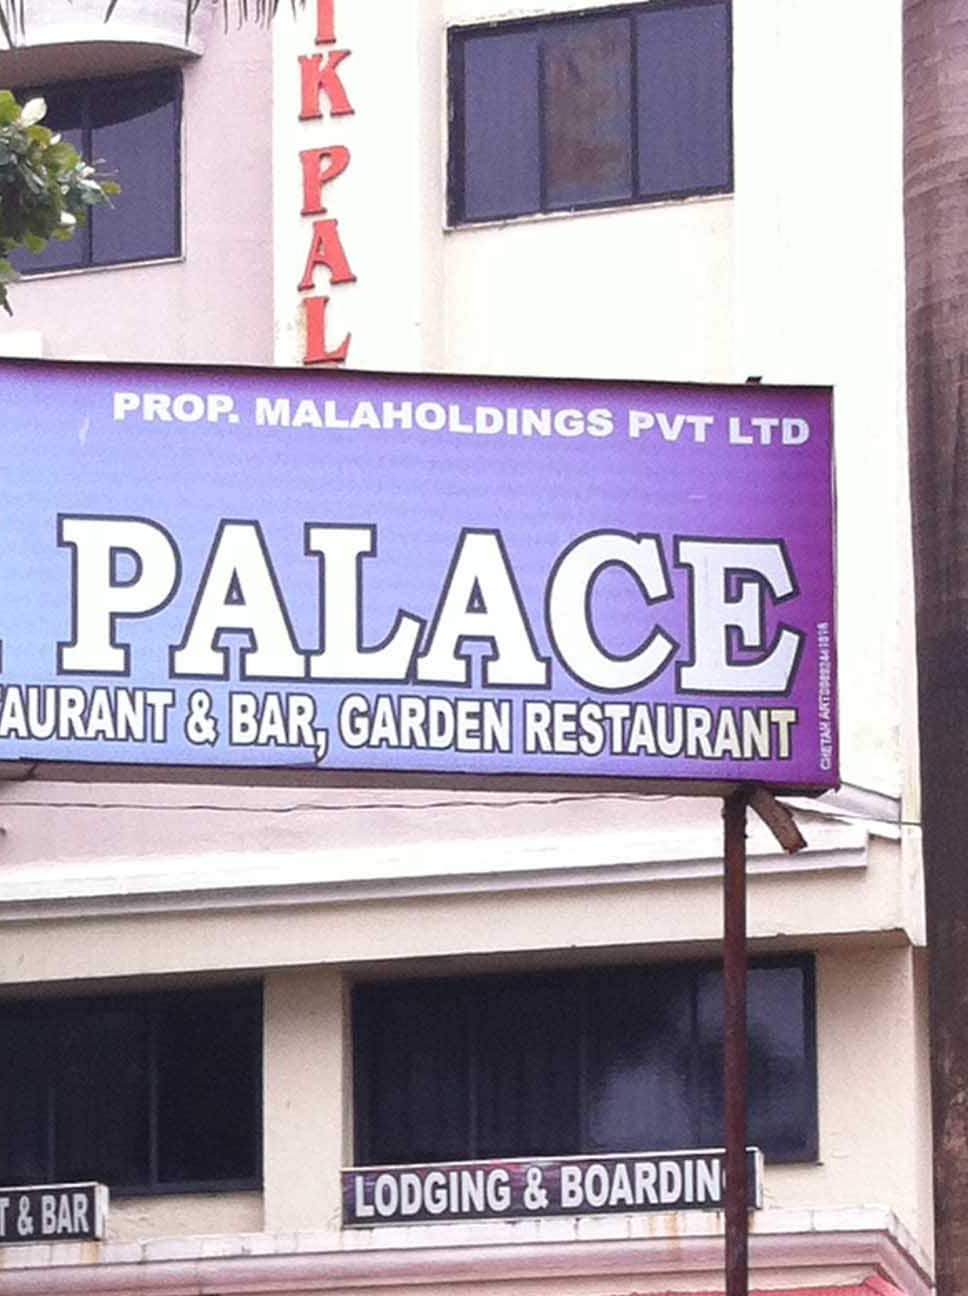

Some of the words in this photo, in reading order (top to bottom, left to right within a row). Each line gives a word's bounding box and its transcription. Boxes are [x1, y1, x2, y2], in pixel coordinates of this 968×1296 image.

[113, 391, 241, 424] PROP.
[255, 397, 615, 439] MALAHOLDINGS
[629, 409, 714, 443] PVT
[728, 416, 810, 446] LTD
[57, 512, 804, 696] PALACE
[185, 688, 219, 747] &
[229, 691, 328, 766] BAR,
[339, 693, 513, 754] GARDEN
[523, 699, 798, 762] RESTAURANT
[17, 1195, 33, 1236] &
[41, 1193, 89, 1235] BAR
[354, 1168, 510, 1217] LODGING
[523, 1166, 548, 1210] &
[561, 1158, 725, 1208] BOARDIN
